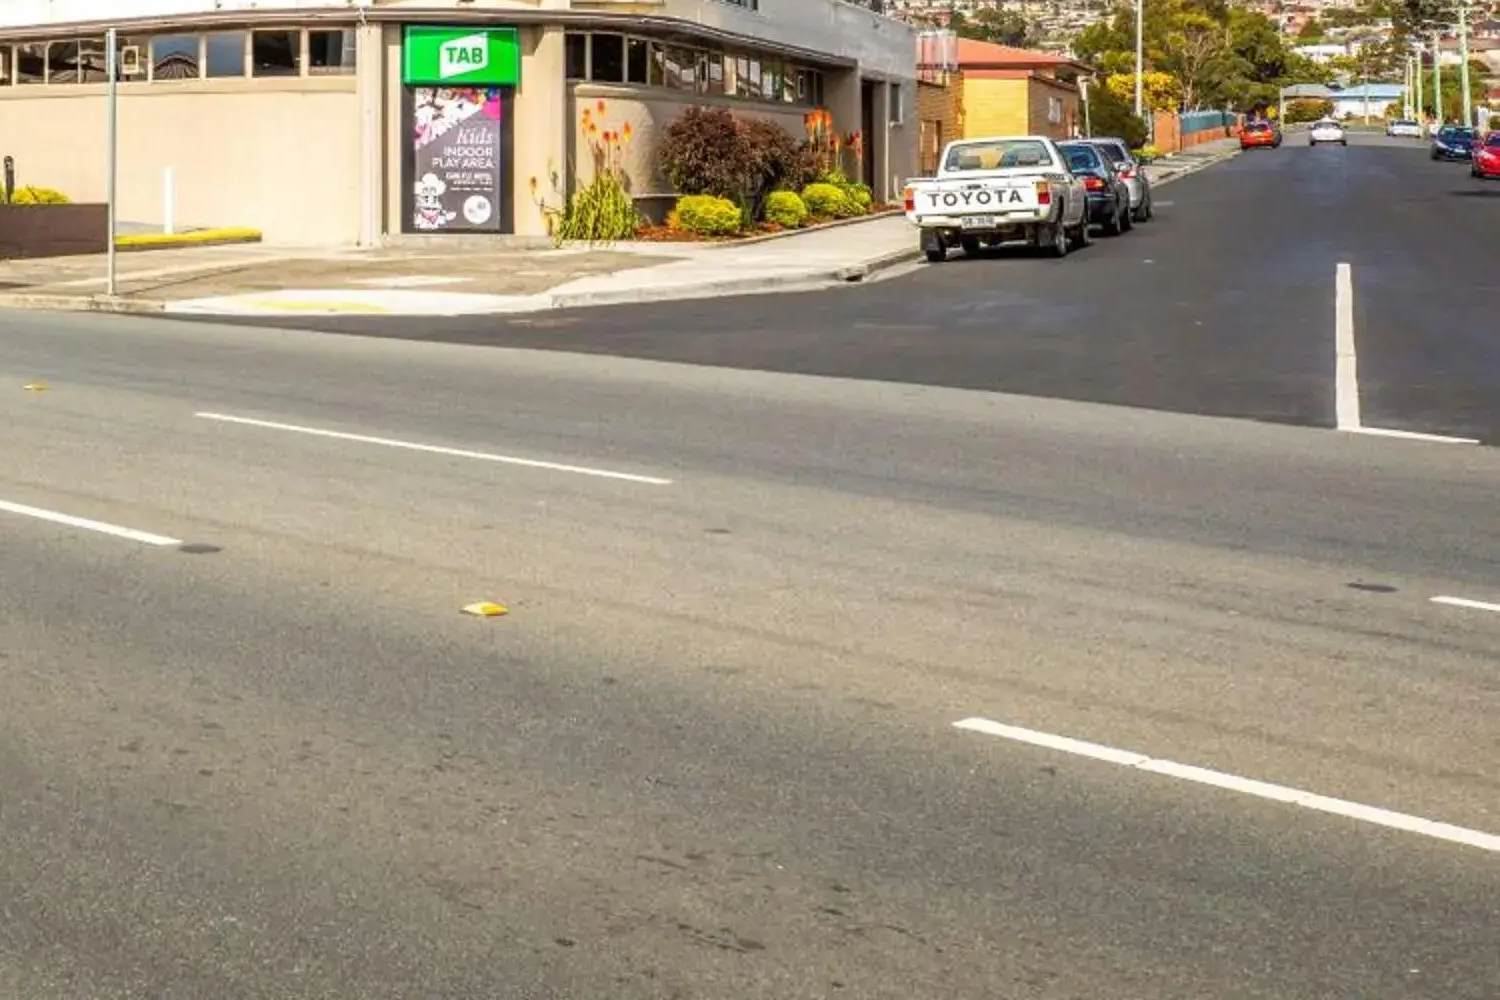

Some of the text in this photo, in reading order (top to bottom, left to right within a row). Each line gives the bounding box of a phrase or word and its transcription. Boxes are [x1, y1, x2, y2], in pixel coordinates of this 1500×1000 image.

[445, 46, 484, 64] TAB
[456, 126, 493, 146] Kids
[443, 145, 494, 157] INDOOR
[431, 157, 495, 169] PLAY AREA
[927, 188, 1024, 208] TOYOTA
